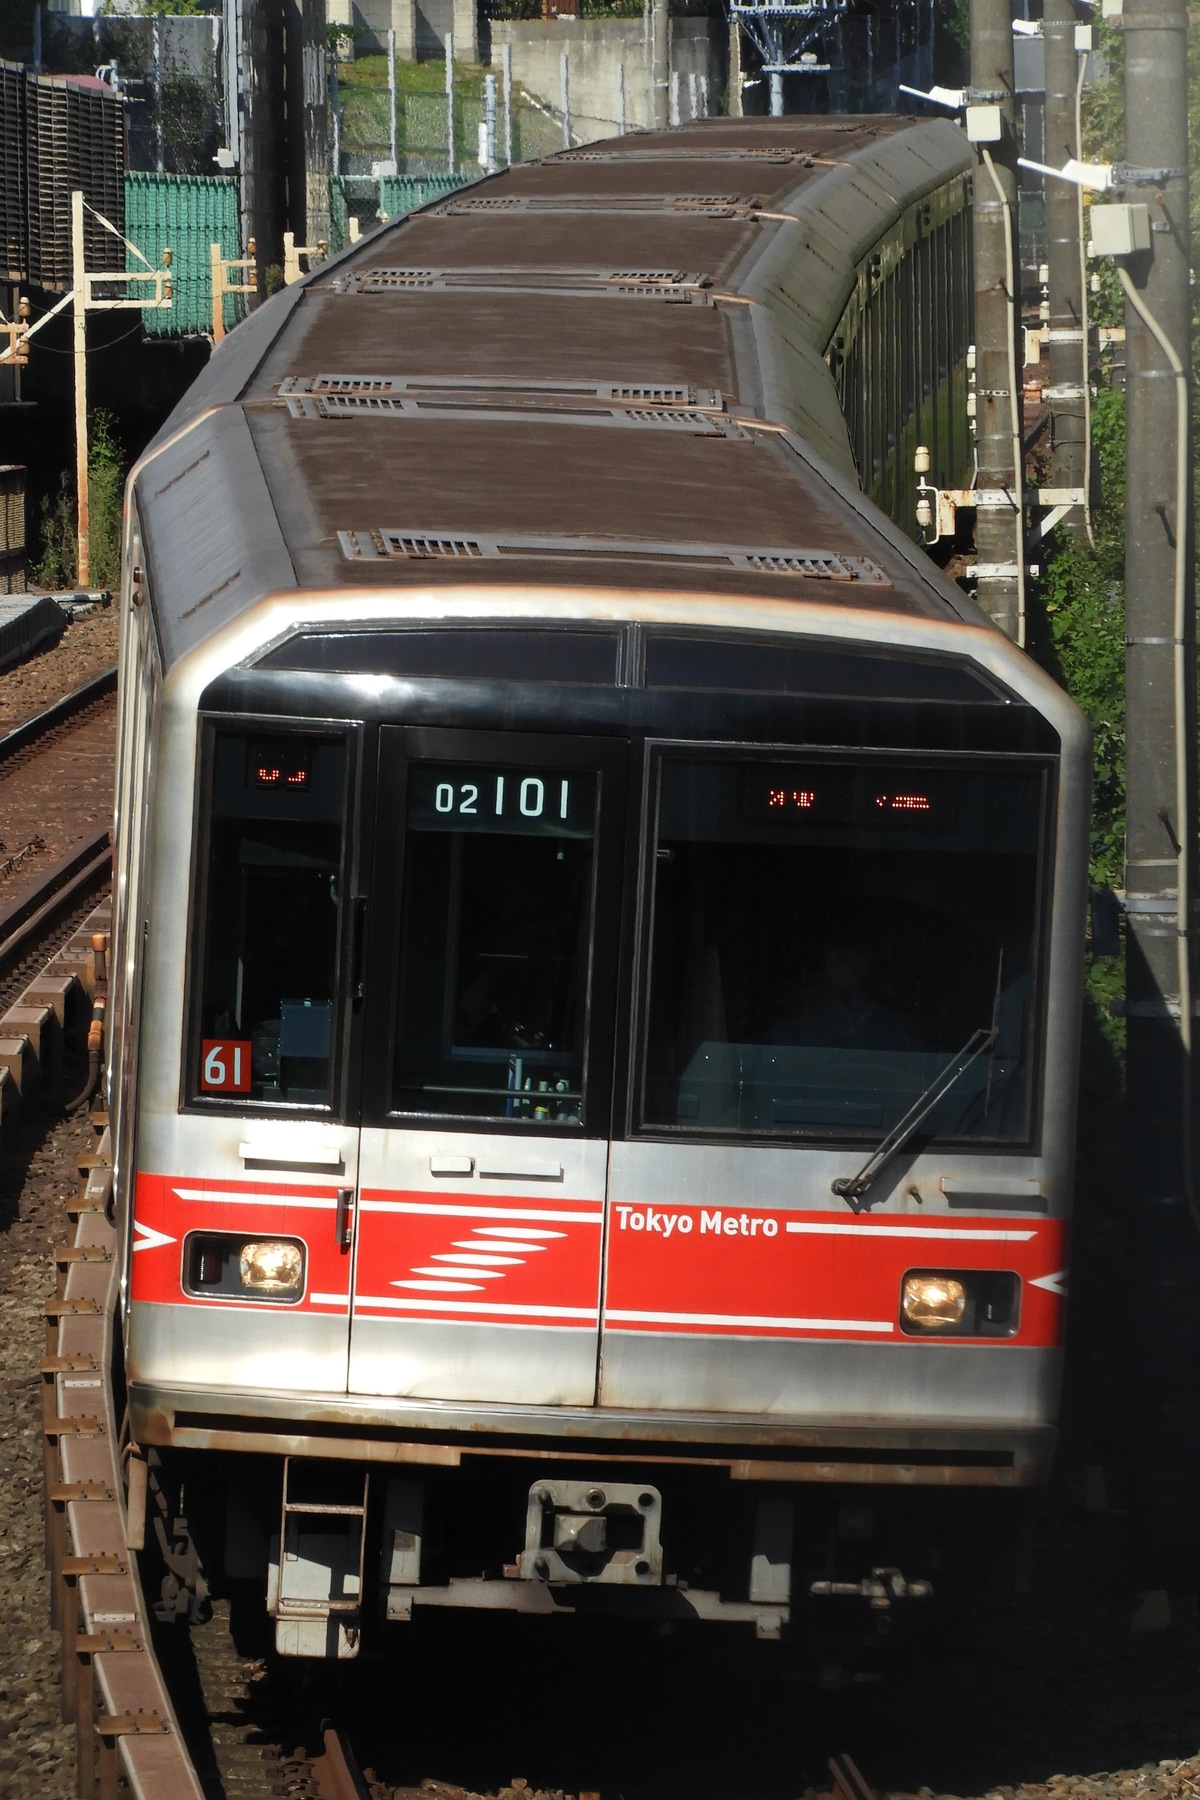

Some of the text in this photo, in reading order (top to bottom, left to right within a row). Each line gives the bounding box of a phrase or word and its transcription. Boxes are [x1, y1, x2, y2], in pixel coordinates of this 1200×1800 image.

[204, 1046, 241, 1085] 61
[615, 1206, 779, 1238] Tokyo Metro
